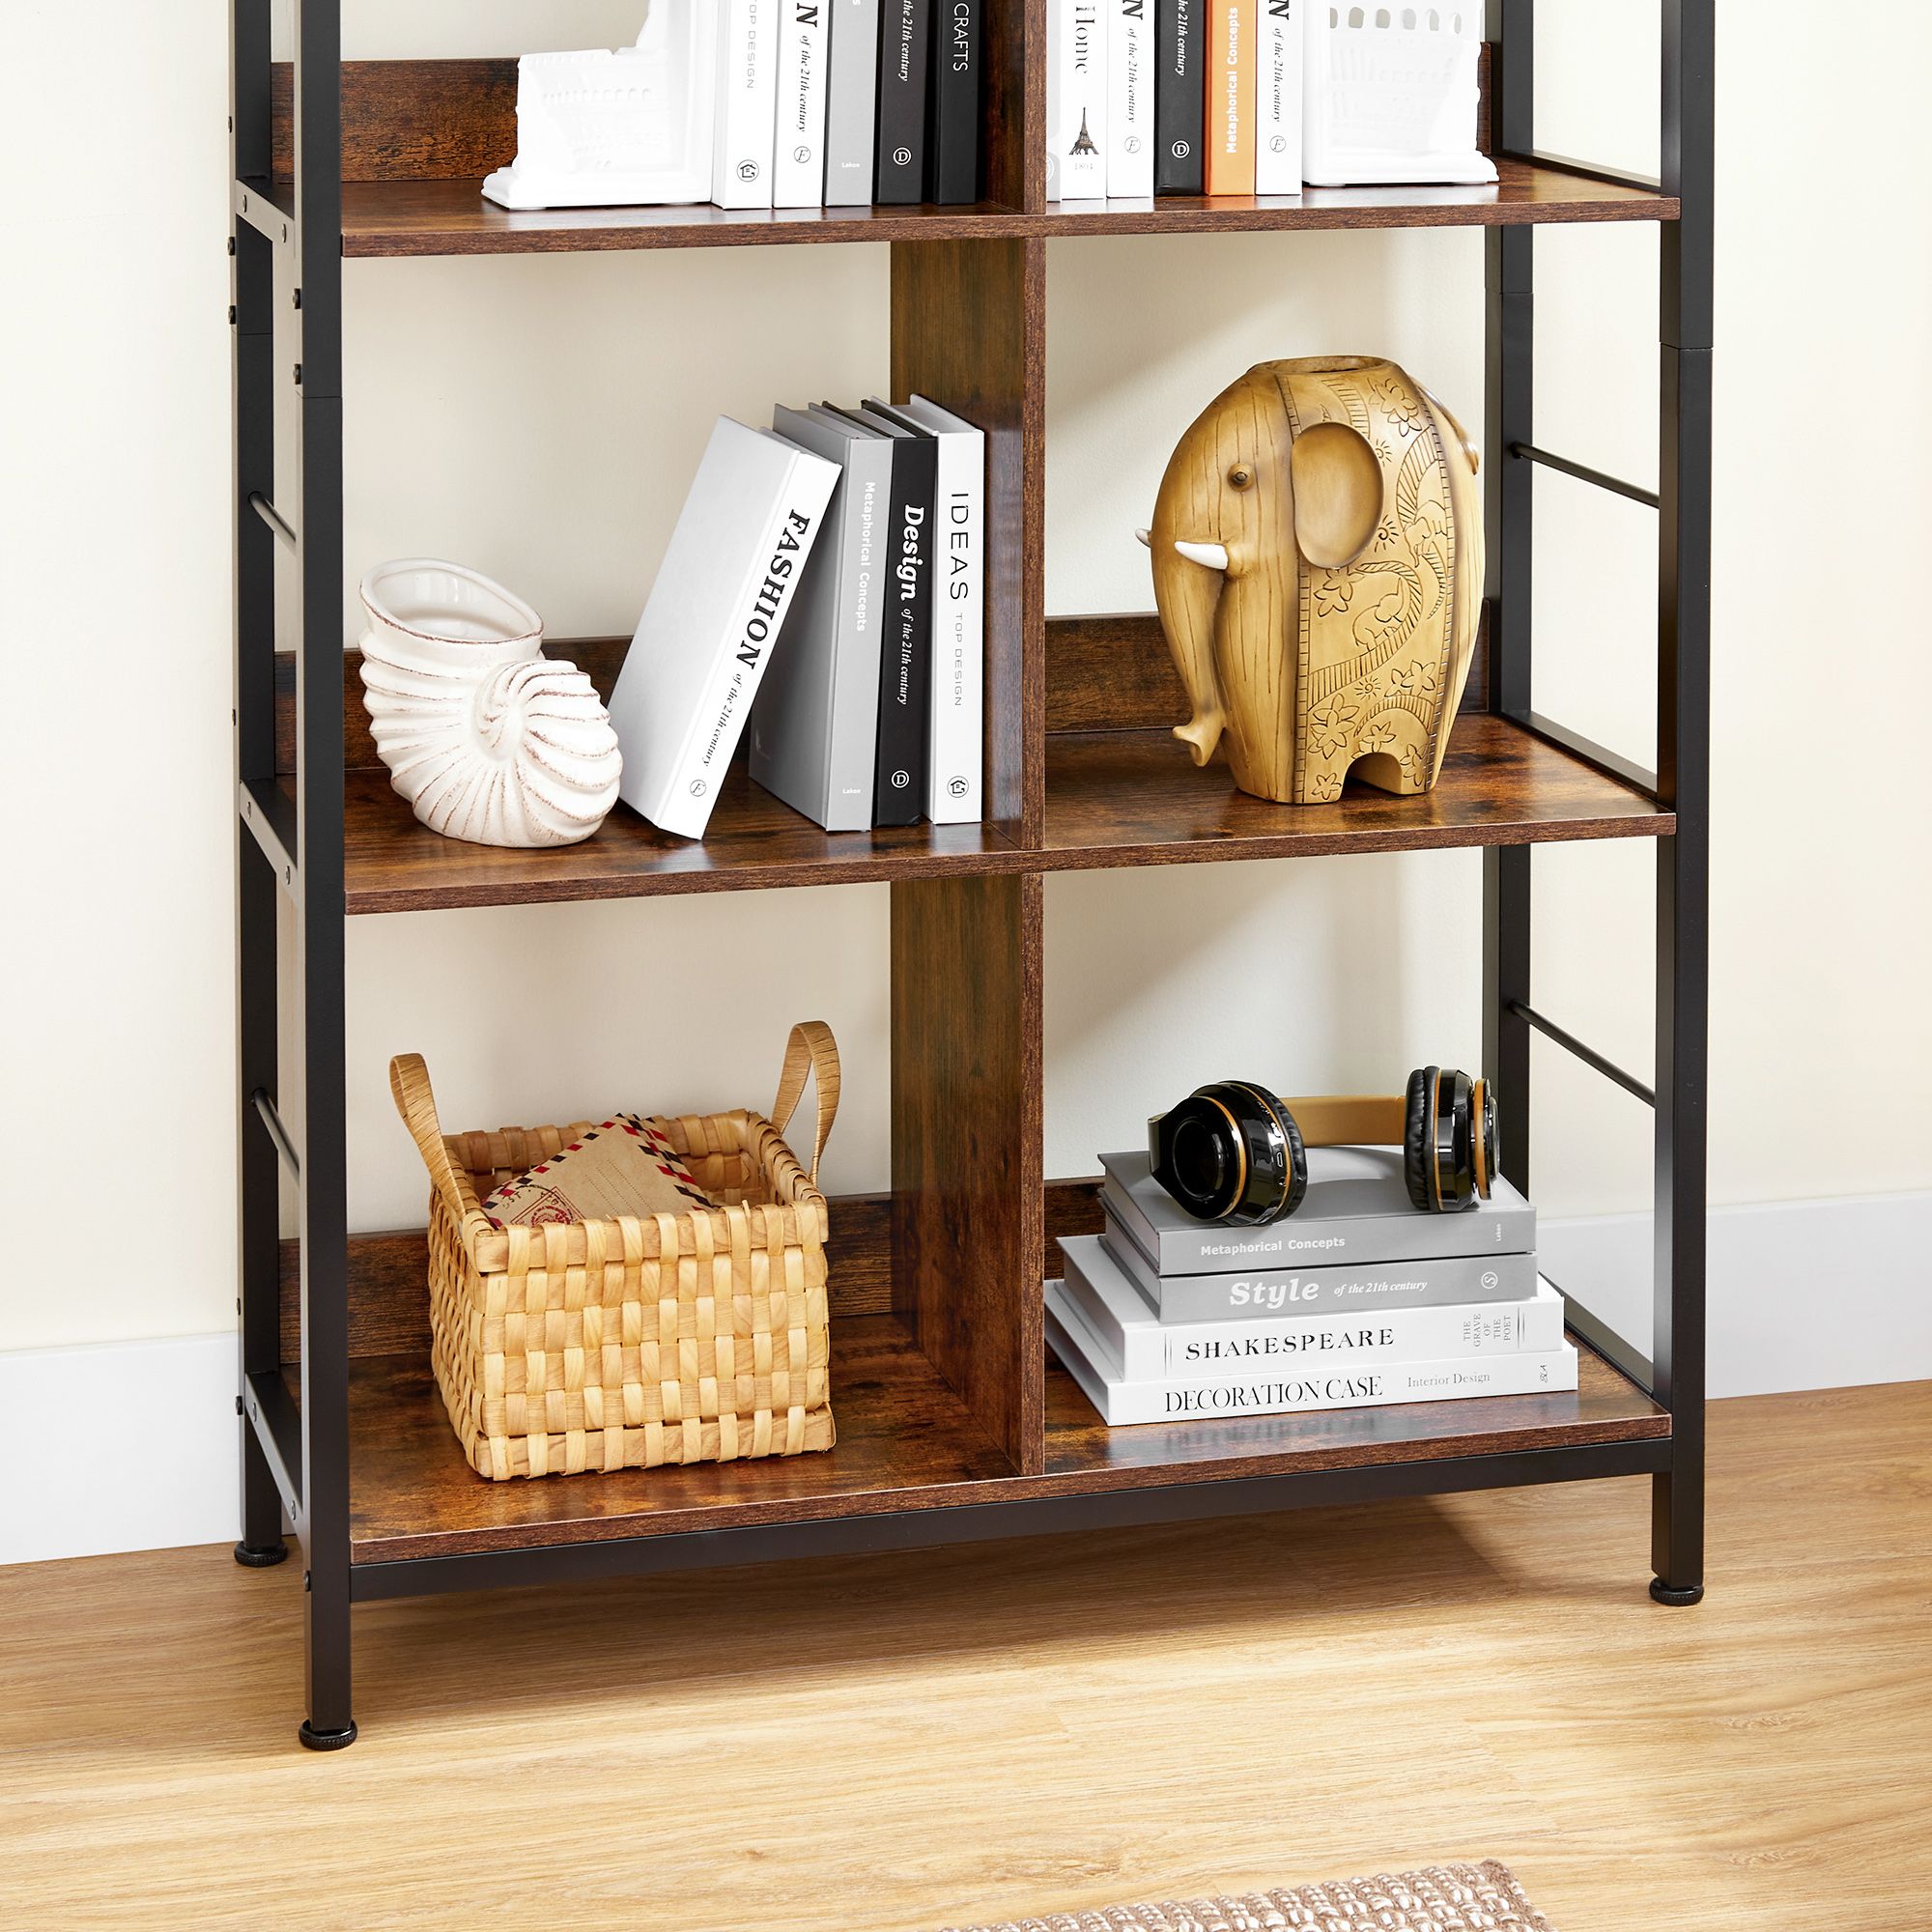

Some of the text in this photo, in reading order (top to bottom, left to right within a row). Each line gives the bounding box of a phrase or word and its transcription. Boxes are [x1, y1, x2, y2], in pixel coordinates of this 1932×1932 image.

[952, 3, 971, 71] CRAFTS
[1075, 6, 1095, 74] Home
[1127, 28, 1139, 40] of
[1178, 13, 1188, 37] 21th
[1273, 28, 1285, 40] of
[747, 0, 757, 89] OP DESIGN
[799, 35, 811, 48] of
[898, 0, 914, 82] the 21th century
[1128, 43, 1138, 58] the
[1274, 43, 1284, 58] the
[801, 50, 811, 67] the
[1128, 60, 1138, 83] 21th
[1175, 38, 1186, 76] century
[1274, 60, 1284, 83] 21th
[800, 68, 810, 91] 21th
[1226, 7, 1240, 154] Metaphorical Concepts
[796, 93, 808, 132] century
[1126, 84, 1136, 123] century
[1272, 84, 1282, 123] century
[855, 481, 876, 632] Metaphorical Concepts
[896, 503, 925, 705] Design of the 21th century
[950, 493, 969, 706] IDEAS TOP DESIGN
[702, 509, 811, 767] FASHION of the 21th century
[1201, 1236, 1346, 1256] Metaphorical Concepts
[1229, 1278, 1429, 1309] Style of the 21th century
[1463, 1321, 1471, 1342] THE
[1473, 1313, 1482, 1348] GRAVE
[1483, 1322, 1492, 1337] OF
[1503, 1315, 1512, 1341] POET
[1185, 1328, 1394, 1360] SHAKESPEARE
[1165, 1376, 1383, 1412] DECORATION CASE
[1407, 1370, 1491, 1387] Interior Design
